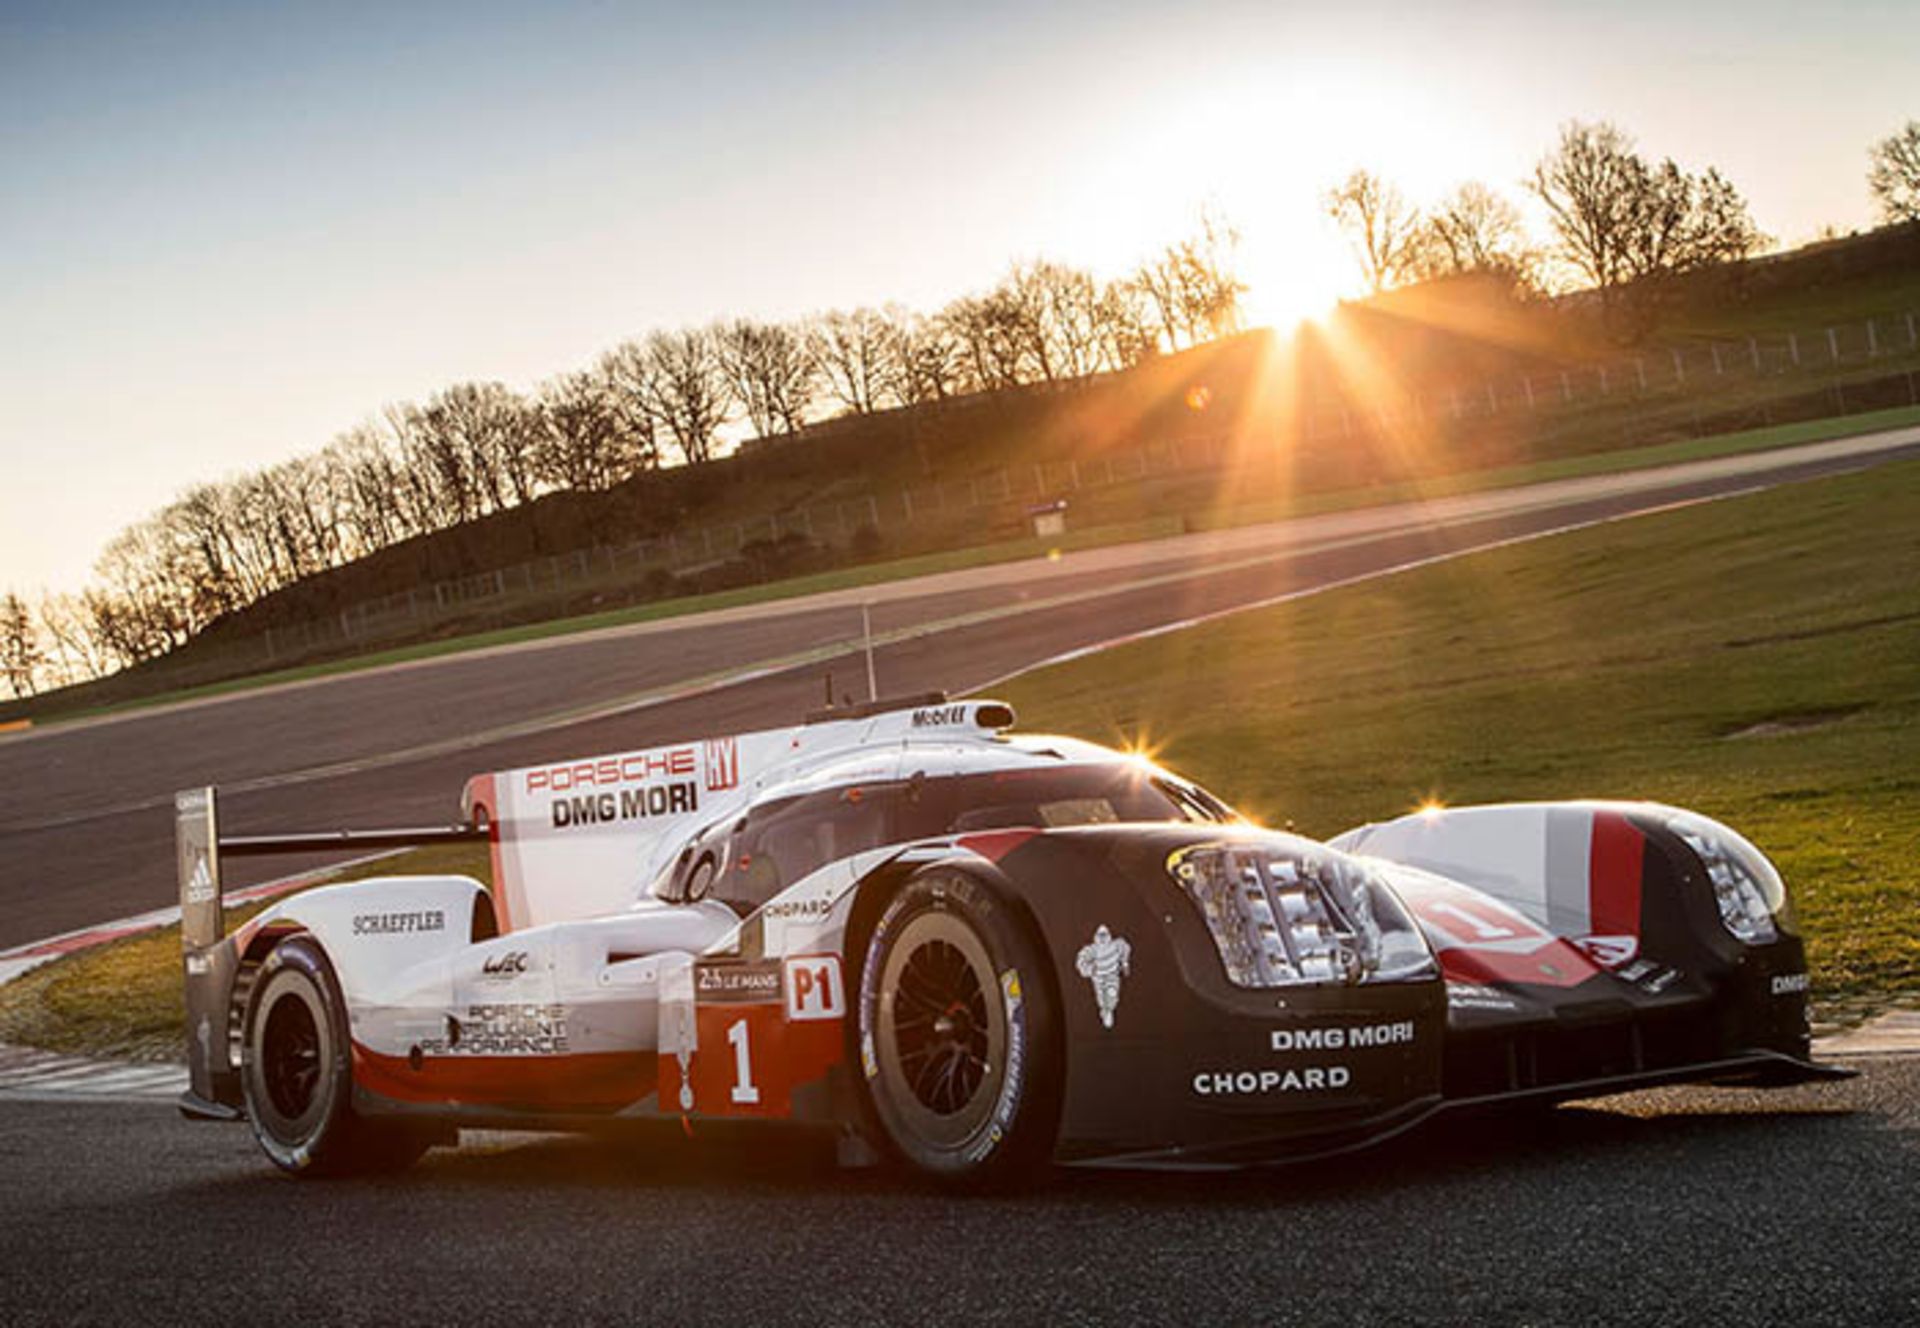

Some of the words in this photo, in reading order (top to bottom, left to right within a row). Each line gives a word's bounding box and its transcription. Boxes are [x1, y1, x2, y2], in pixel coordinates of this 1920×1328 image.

[526, 749, 695, 795] PORSCHE
[553, 793, 617, 828] DMG
[620, 782, 698, 819] MORI
[353, 910, 445, 935] SCHAEFFLER
[765, 900, 833, 918] CHOPARD
[723, 974, 739, 989] LE
[741, 973, 779, 990] MANS
[794, 966, 834, 1011] P1
[1271, 1028, 1345, 1050] DMG
[1350, 1020, 1414, 1047] MORI
[728, 1018, 760, 1104] 1
[1193, 1066, 1350, 1094] CHOPARD
